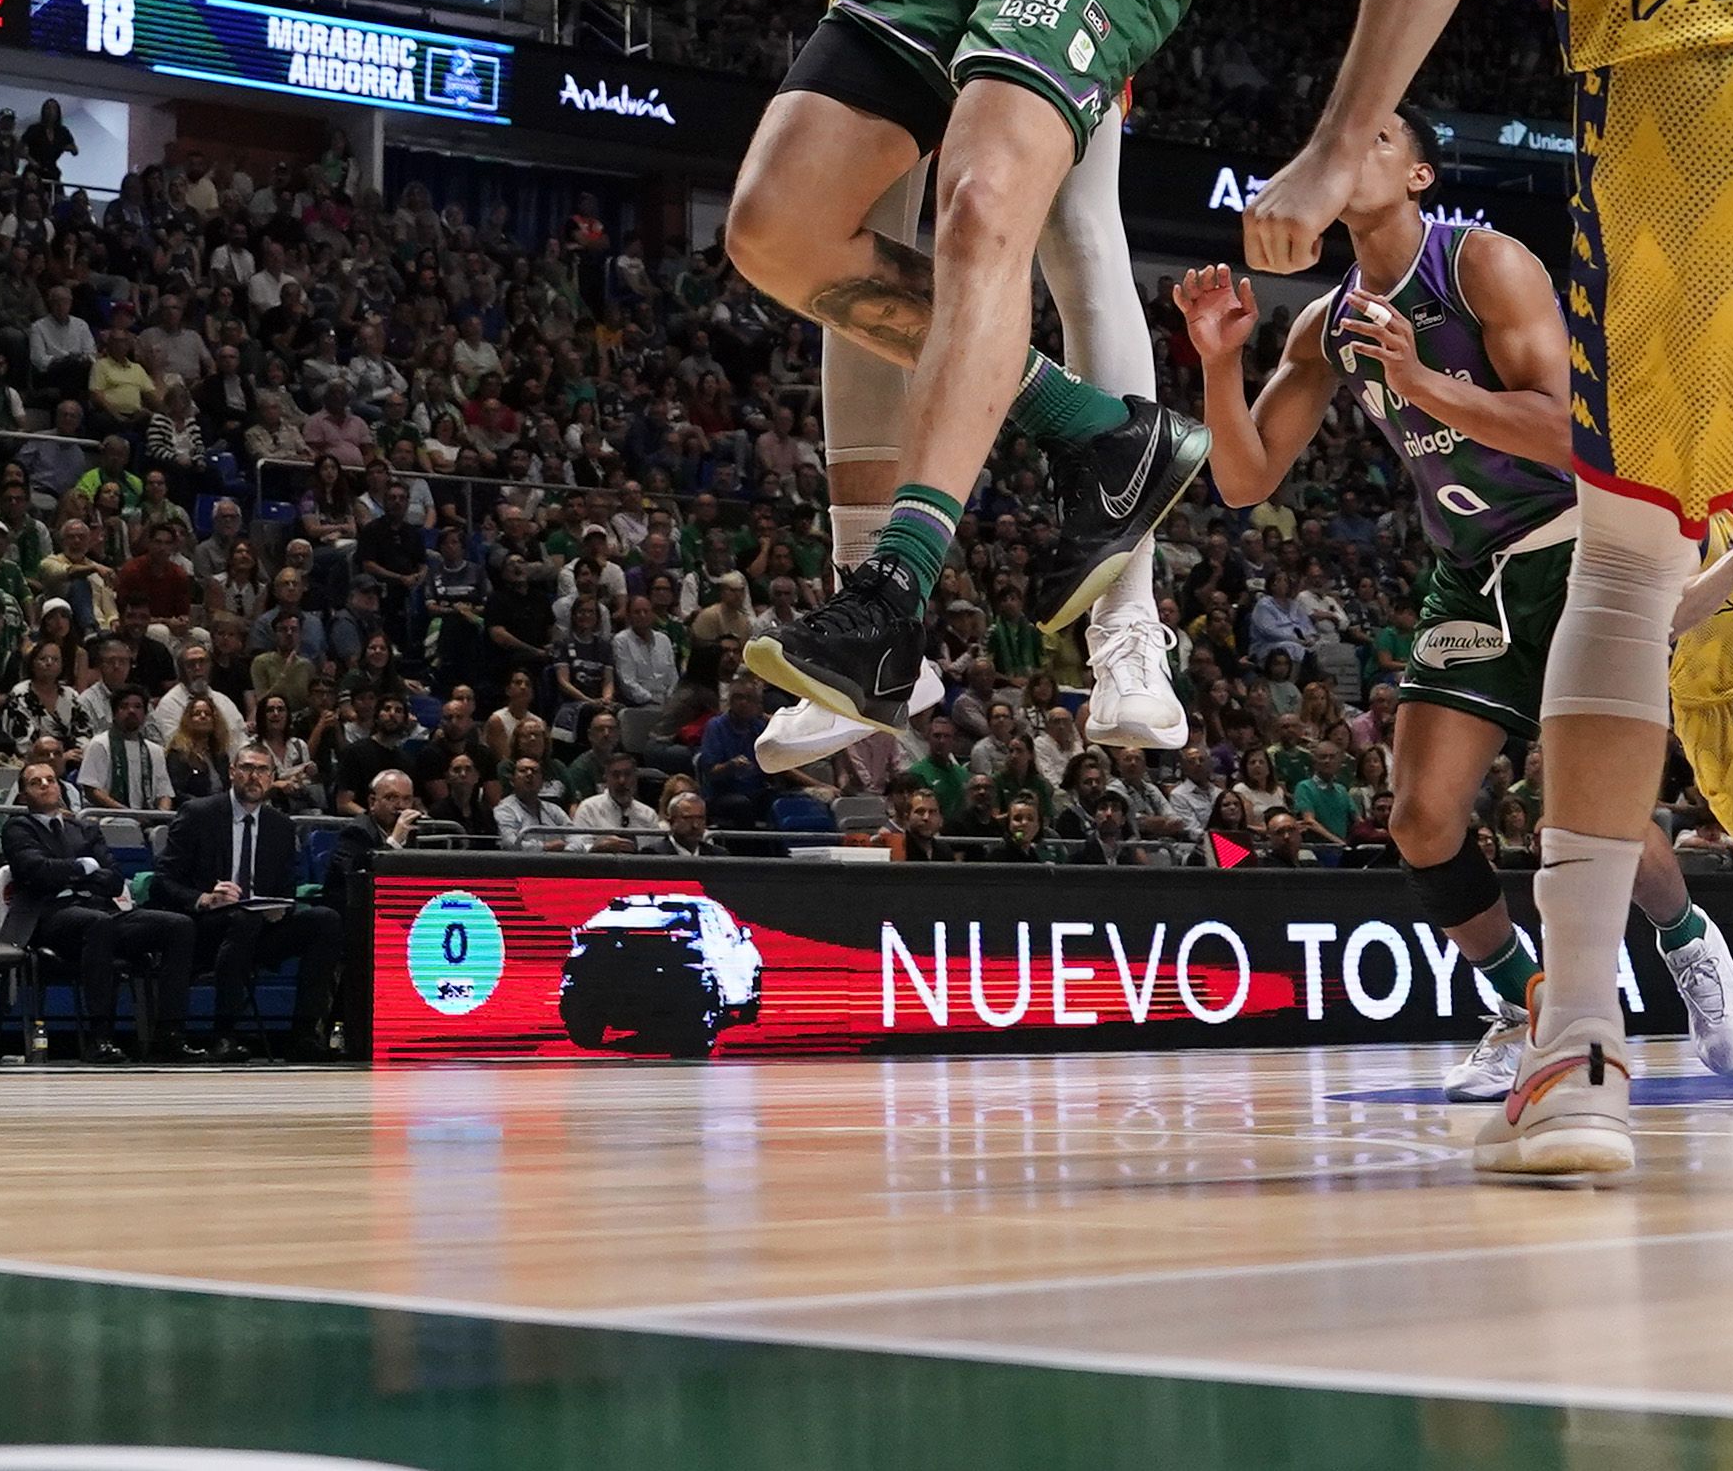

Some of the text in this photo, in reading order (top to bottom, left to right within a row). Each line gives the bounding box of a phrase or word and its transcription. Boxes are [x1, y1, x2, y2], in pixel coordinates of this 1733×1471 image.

[267, 16, 418, 70] MORABANC
[289, 53, 416, 102] ANDORRA
[559, 74, 676, 125] Andalucía
[443, 922, 468, 965] 0
[881, 920, 1252, 1028] NUEVO
